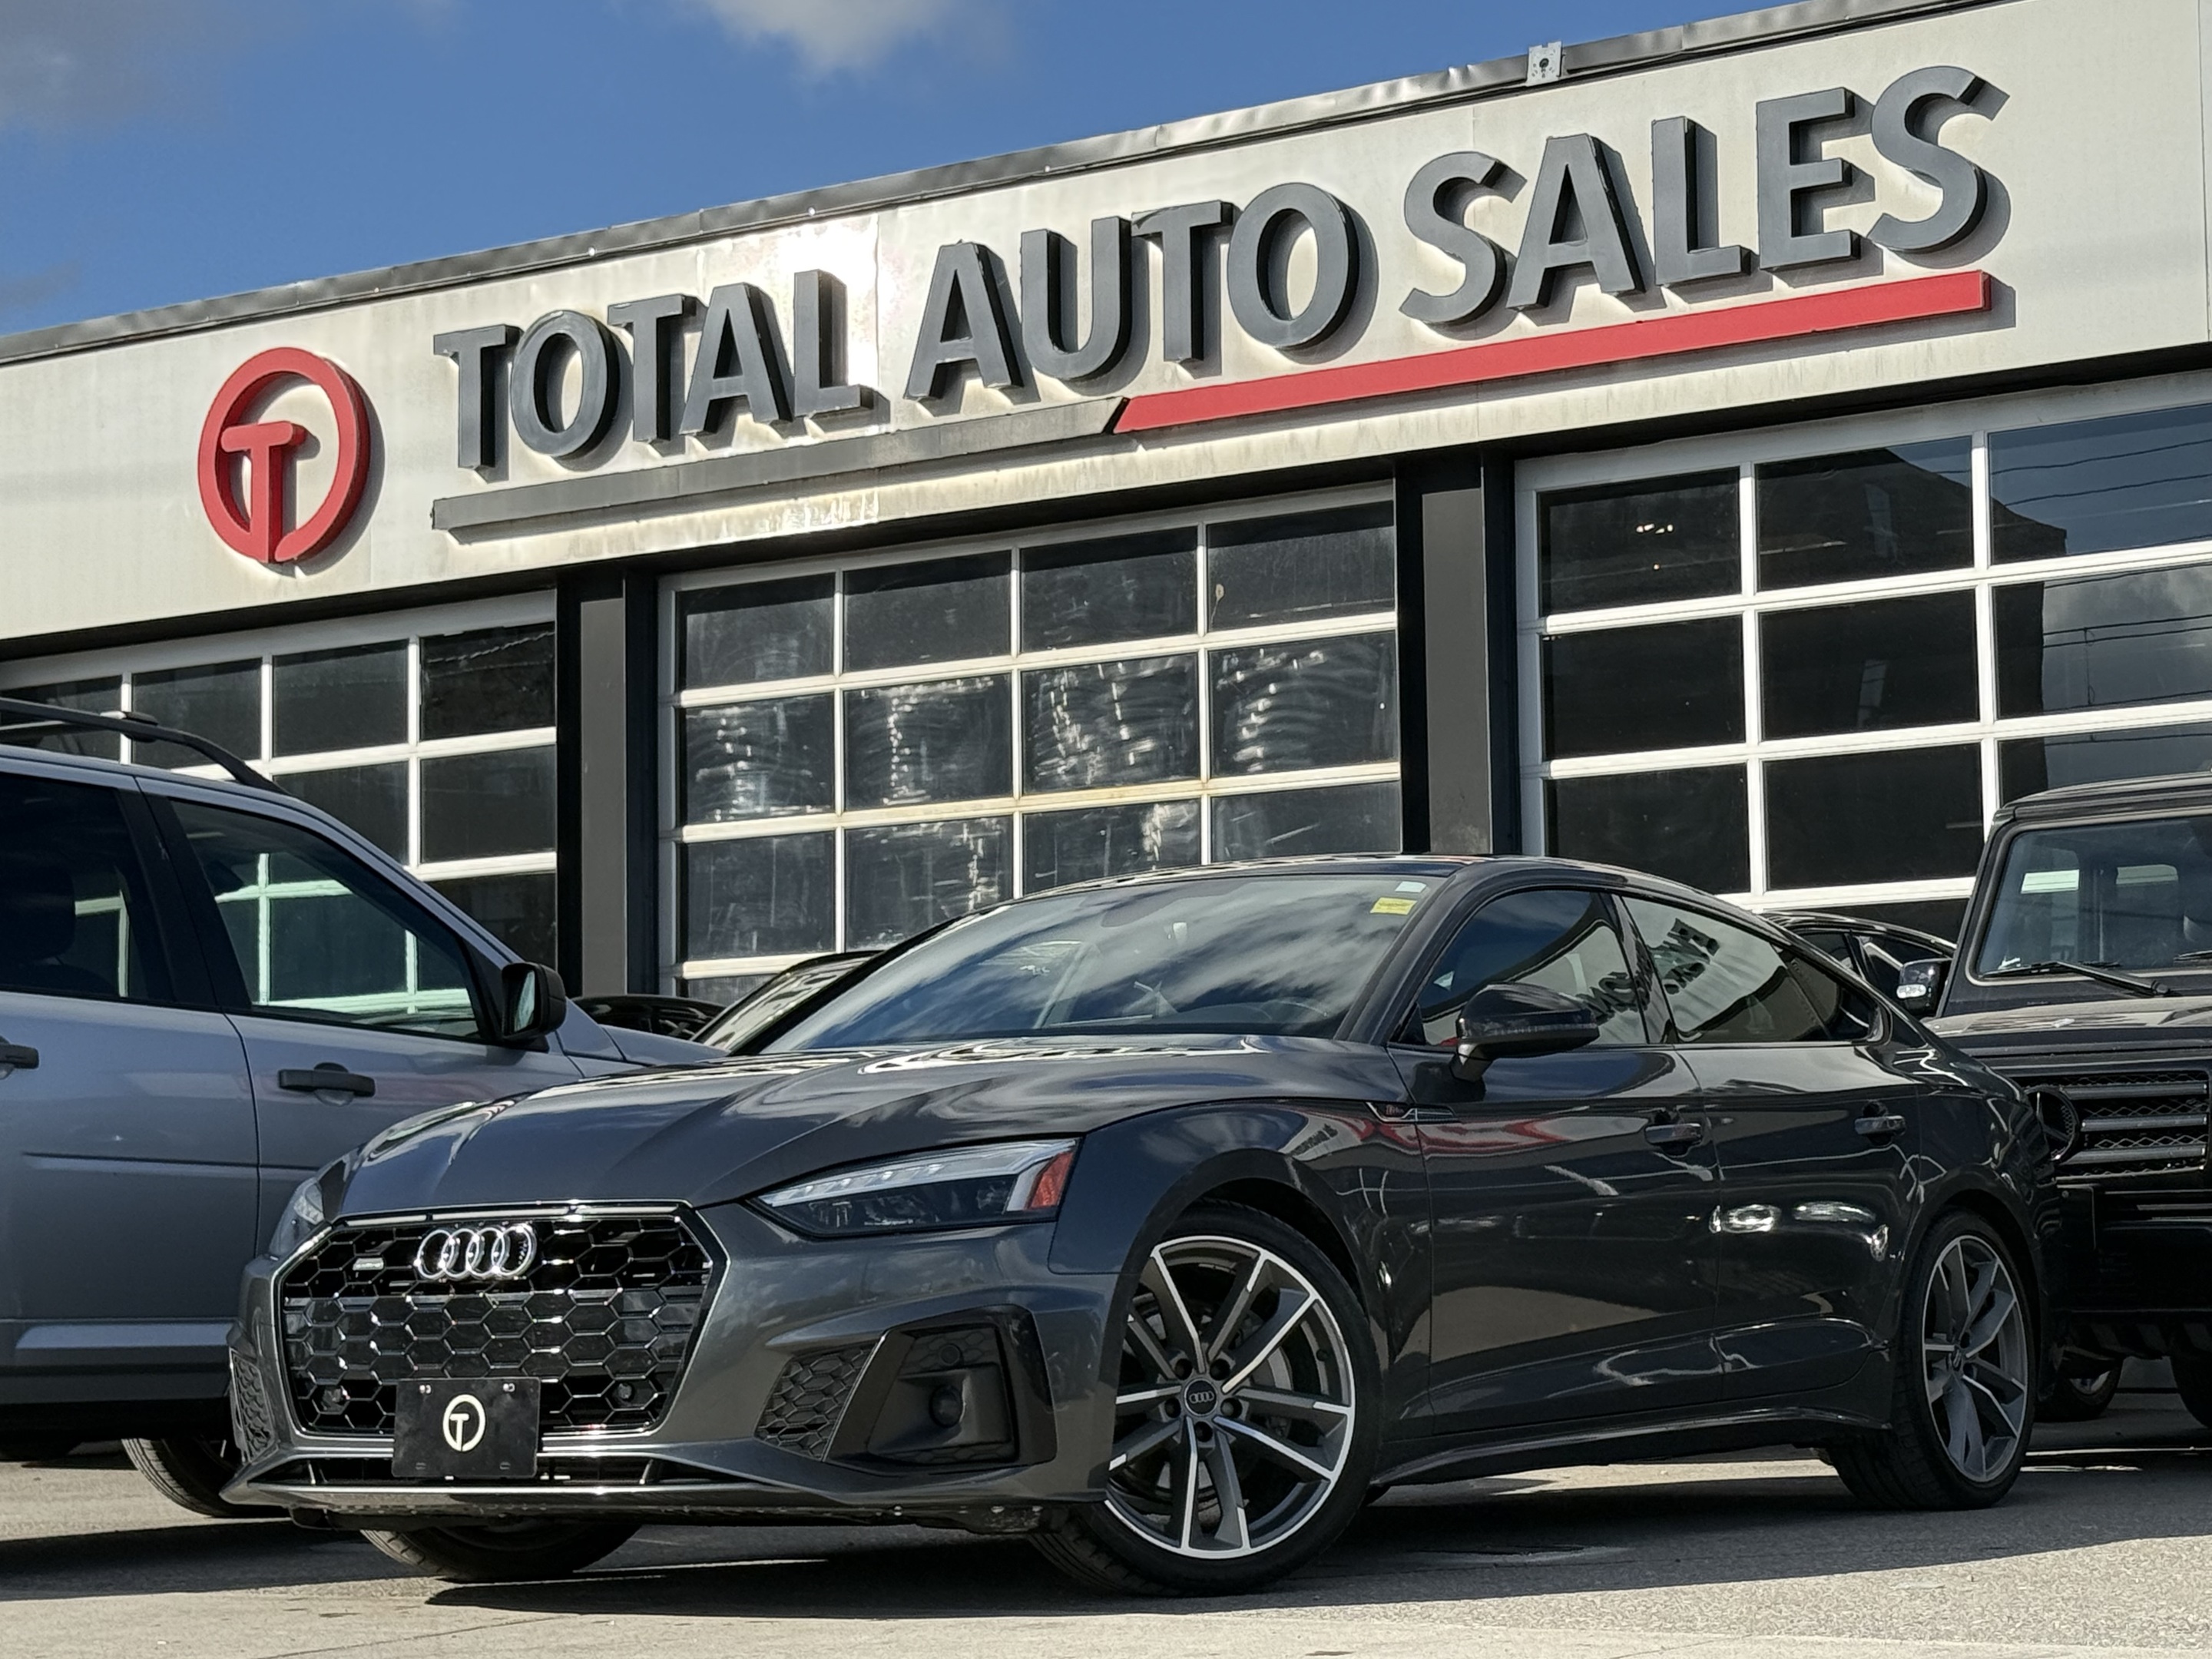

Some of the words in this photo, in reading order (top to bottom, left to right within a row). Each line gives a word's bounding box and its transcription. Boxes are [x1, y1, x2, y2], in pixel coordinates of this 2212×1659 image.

[433, 269, 869, 472] TOTAL
[906, 181, 1364, 401] AUTO
[1401, 65, 2006, 327] SALES
